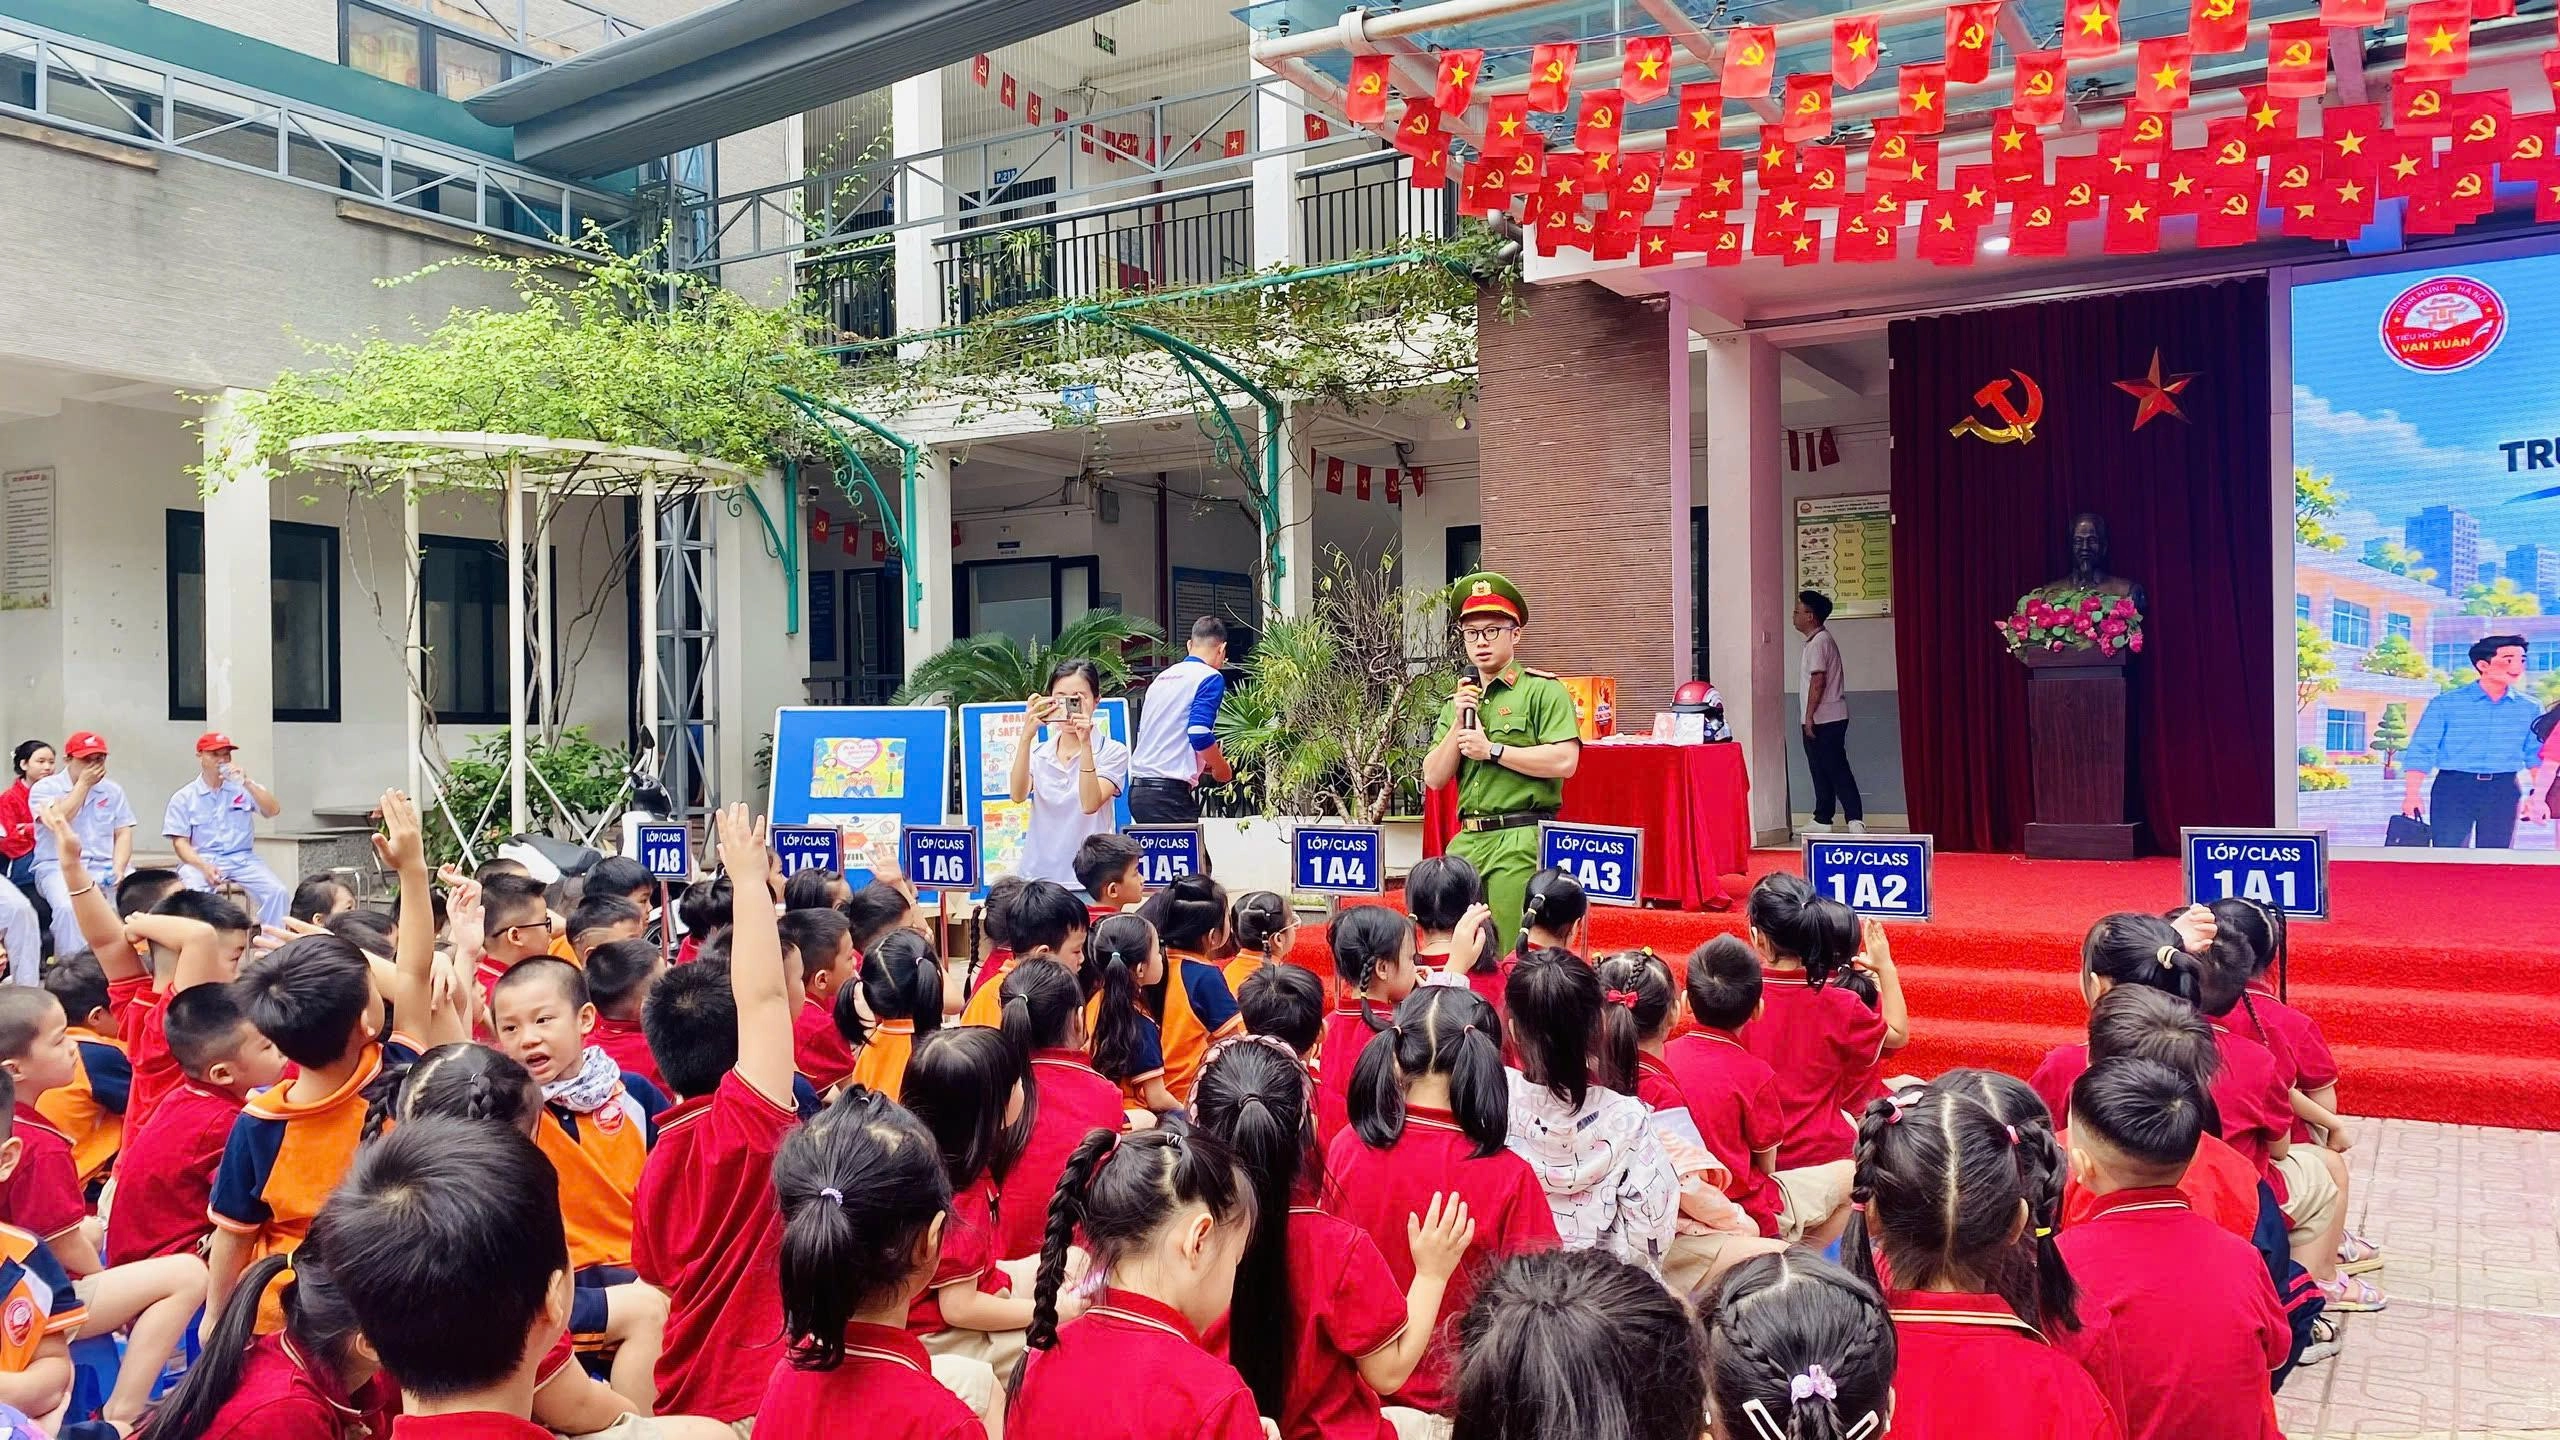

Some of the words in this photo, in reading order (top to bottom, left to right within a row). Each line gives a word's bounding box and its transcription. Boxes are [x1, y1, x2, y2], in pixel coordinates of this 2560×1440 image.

[2498, 437, 2560, 472] TR
[998, 726, 1025, 737] SAFE
[646, 830, 681, 843] LỚP/CLASS
[783, 834, 830, 846] LỚP/CLASS
[917, 836, 965, 850] LỚP/CLASS
[1136, 835, 1190, 849] ỚP/CLASS
[1307, 836, 1368, 851] LỚP/CLASS
[1556, 835, 1625, 854] LỚP/CLASS
[647, 847, 681, 872] 1A8
[1825, 848, 1909, 866] LỚP/CLASS
[2206, 843, 2301, 861] LỚP/CLASS
[784, 852, 830, 876] 1A7
[919, 855, 964, 882] 1A6
[1138, 854, 1190, 881] 1A5
[1309, 857, 1366, 885] 1A4
[1828, 873, 1908, 909] 1A2
[2213, 869, 2296, 907] 1A1
